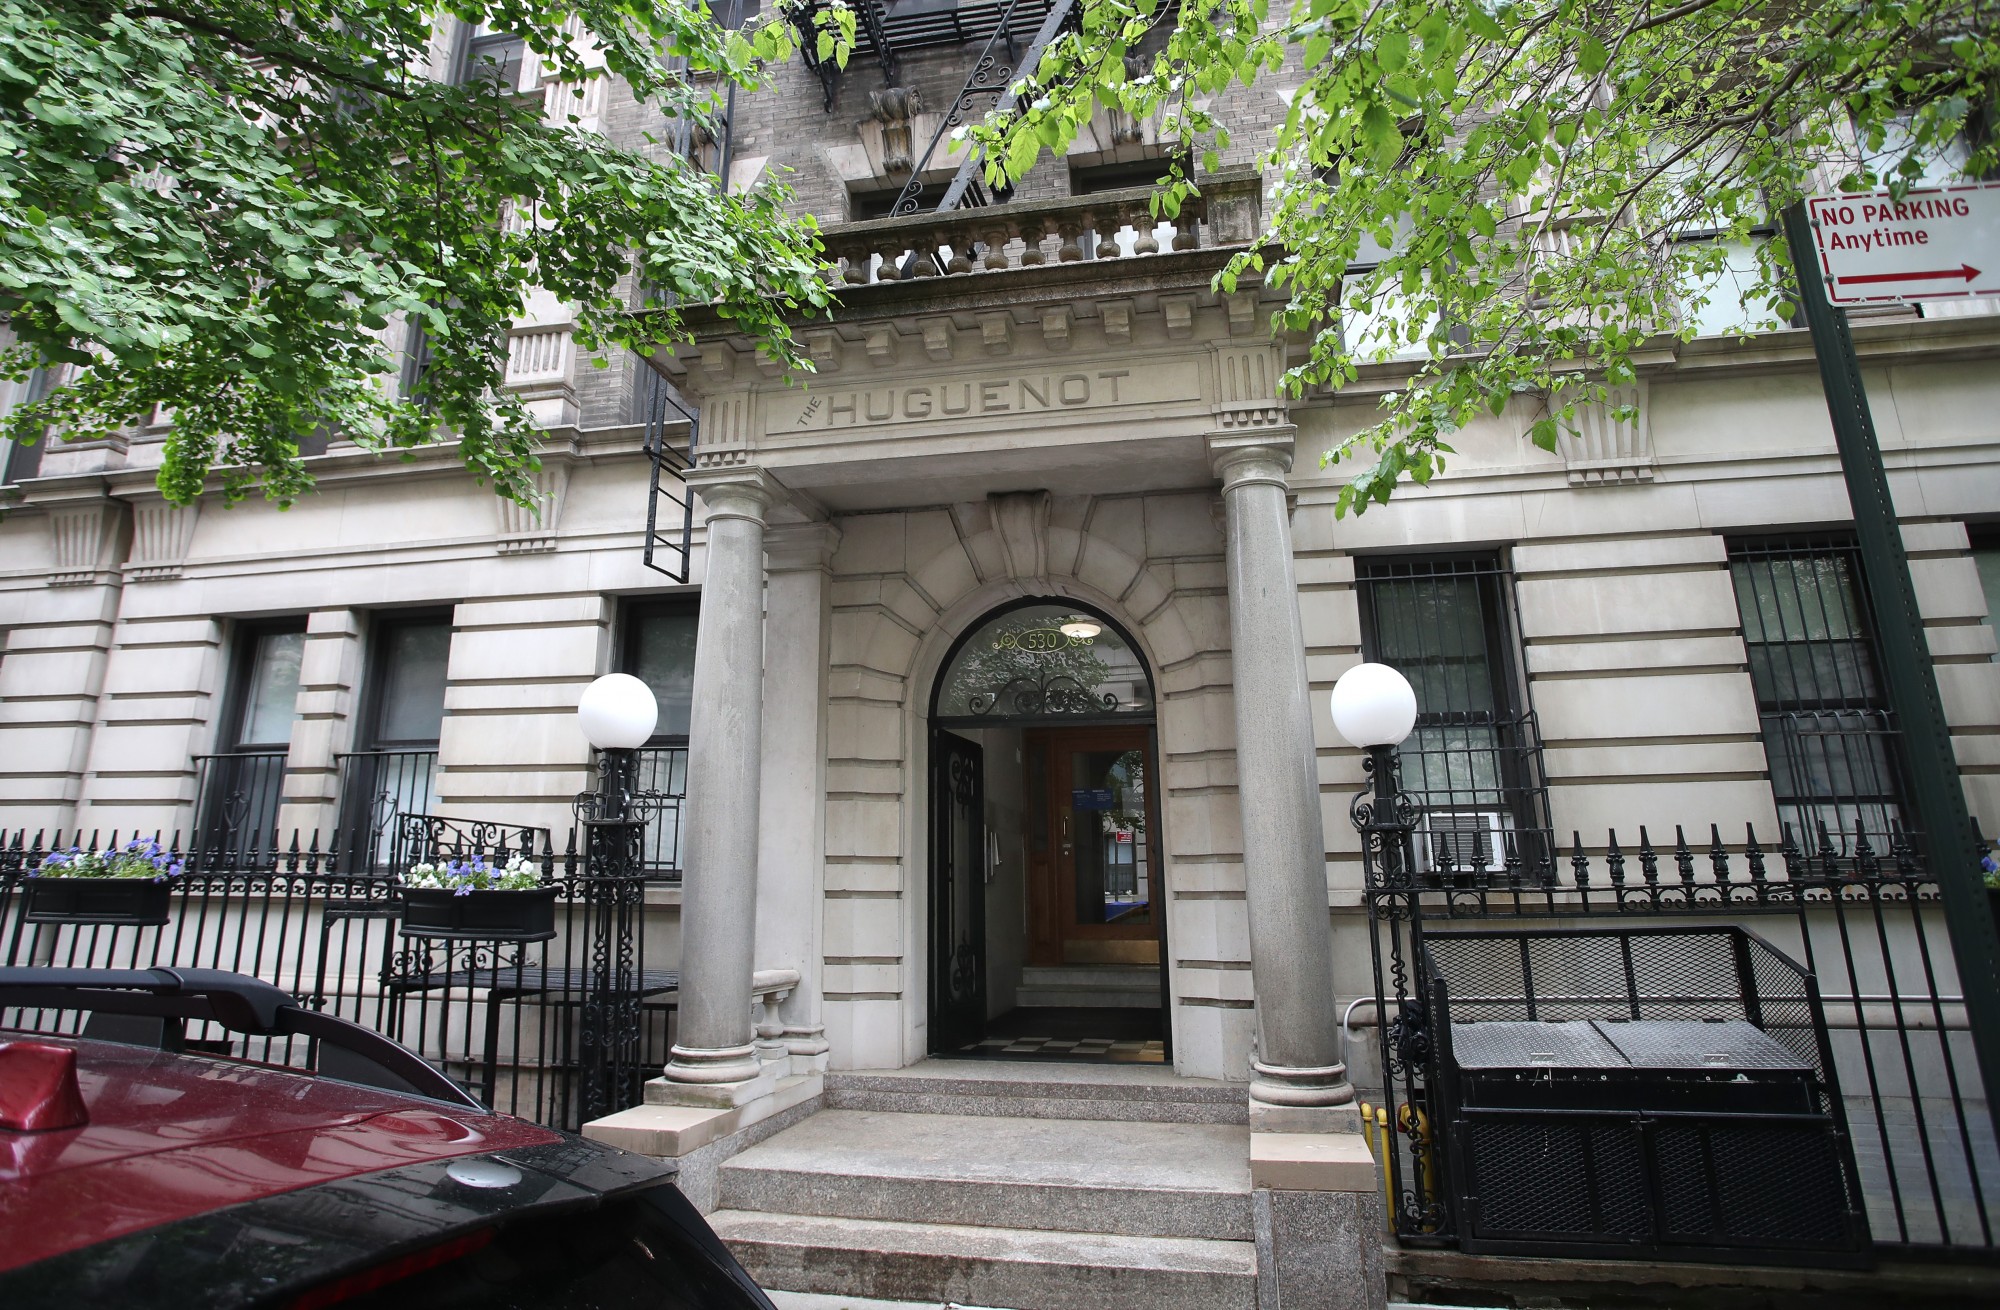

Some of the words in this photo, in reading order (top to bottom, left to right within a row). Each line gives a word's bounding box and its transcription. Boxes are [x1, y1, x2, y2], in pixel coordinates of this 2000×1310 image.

[1821, 206, 1855, 226] NO
[1862, 197, 1970, 223] PARKING
[1830, 228, 1929, 252] Anytime
[797, 396, 822, 427] THE
[827, 370, 1130, 425] HUGUENOT
[1028, 633, 1057, 649] 530
